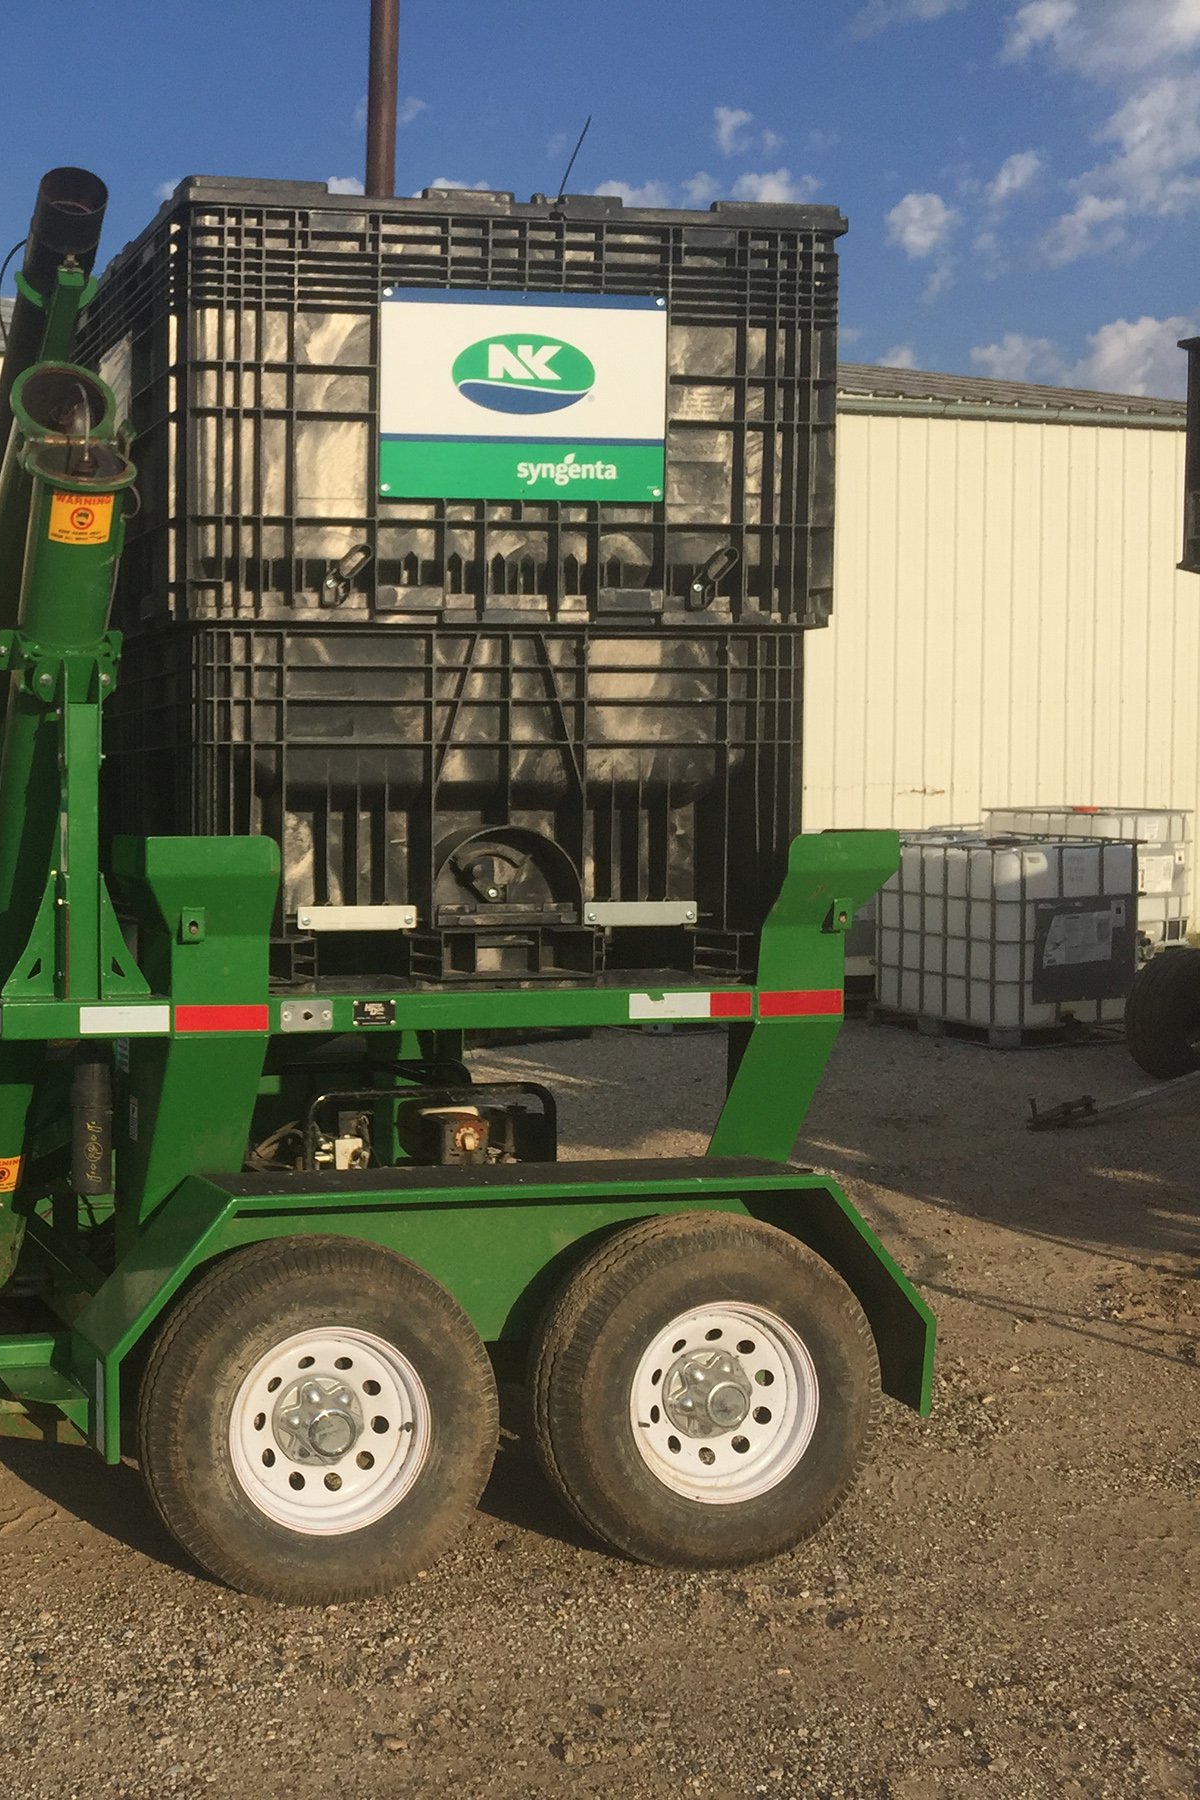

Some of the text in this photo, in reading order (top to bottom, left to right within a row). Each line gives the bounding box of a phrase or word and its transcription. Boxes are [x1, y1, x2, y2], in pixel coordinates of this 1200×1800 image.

[487, 343, 563, 381] NK
[516, 455, 618, 486] syngenta
[55, 493, 112, 506] WARNING
